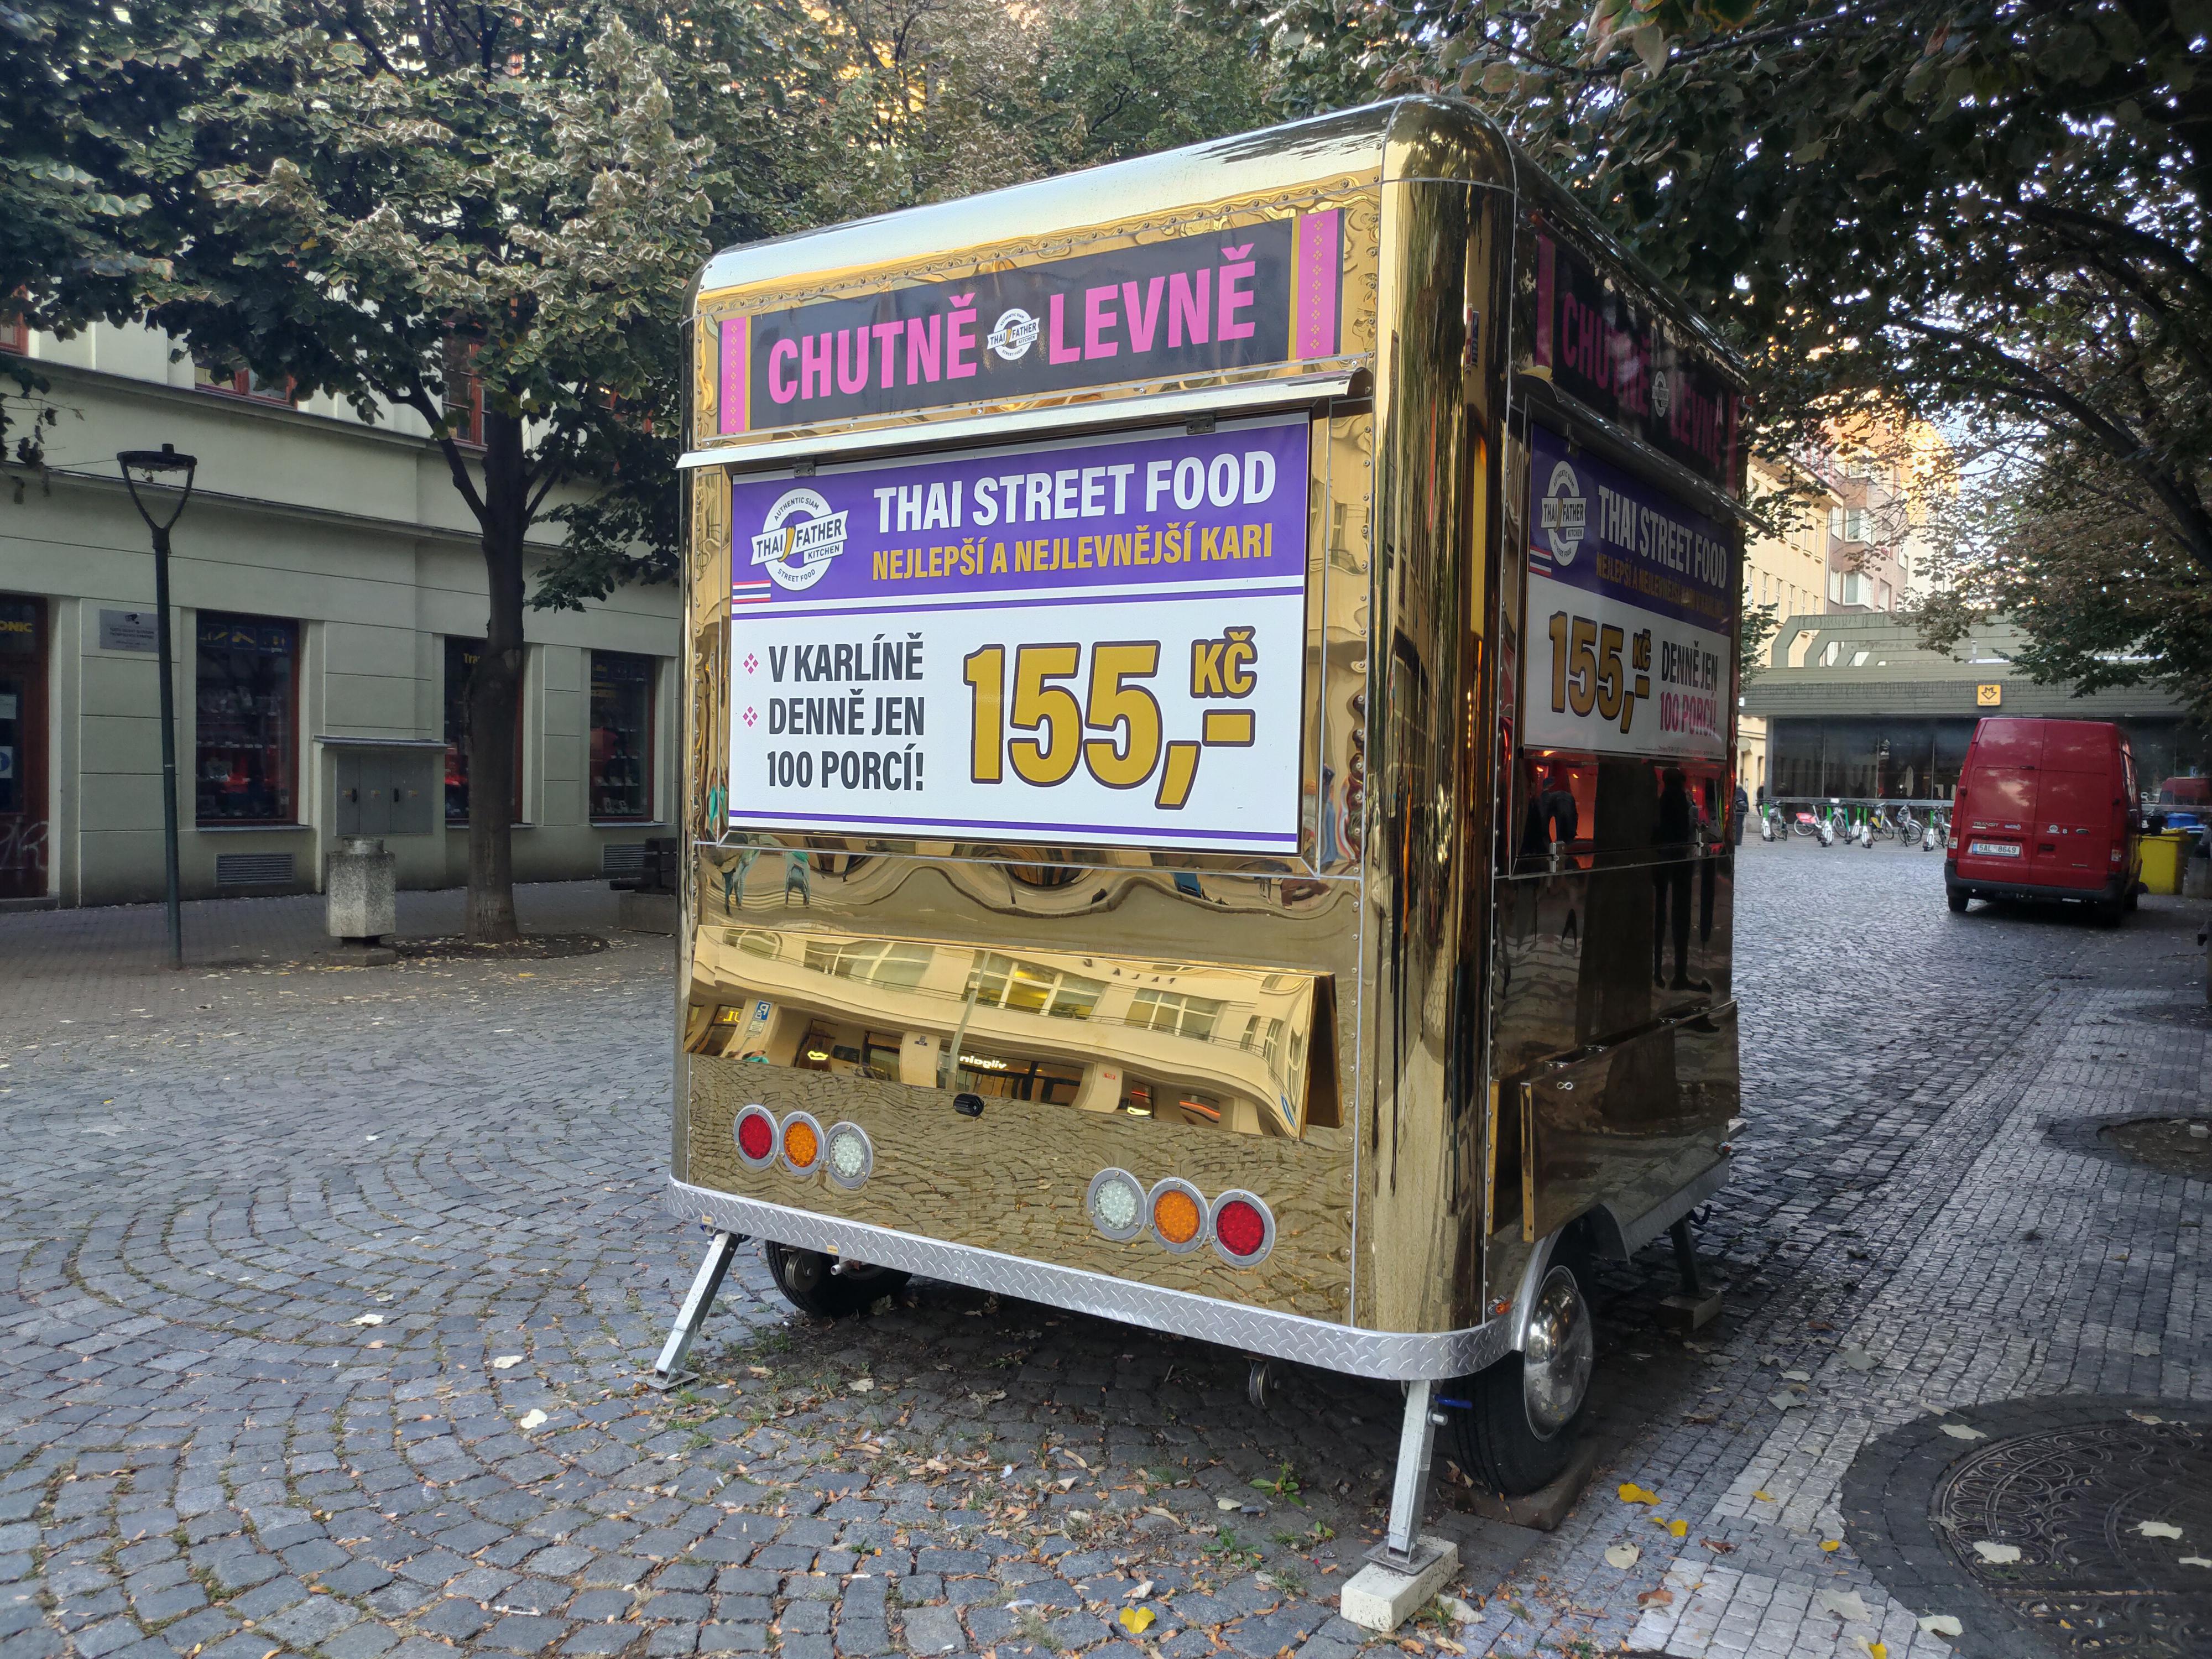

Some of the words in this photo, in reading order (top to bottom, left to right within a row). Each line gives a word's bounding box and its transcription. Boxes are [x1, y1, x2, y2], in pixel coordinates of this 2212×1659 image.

[769, 293, 977, 403] CHUTNĚ
[1050, 243, 1255, 364] LEVNĚ
[990, 332, 1005, 345] THAI
[1012, 322, 1037, 338] FATHER
[774, 497, 804, 521] AUTHENTIC
[805, 498, 819, 510] SIAM
[874, 481, 962, 533] THAI
[972, 464, 1135, 526] STREET
[1146, 451, 1276, 512] FOOD
[1544, 504, 1557, 522] THAI
[1563, 504, 1583, 522] FATHER
[757, 534, 783, 557] THAI
[796, 518, 842, 547] FATHER
[808, 545, 839, 560] KITCHEN
[873, 537, 987, 581] NEJLEPŠÍ
[990, 542, 1008, 574] A
[1015, 521, 1195, 572] NEJLEVNĚJŠÍ
[1201, 523, 1272, 561] KARI
[1599, 484, 1636, 551] THAI
[1640, 507, 1692, 575] STREET
[1694, 534, 1726, 589] FOOD
[778, 568, 799, 582] STREET
[800, 568, 816, 582] FOOD
[769, 646, 788, 682] V
[795, 632, 923, 681] KARLÍNĚ
[1662, 640, 1699, 687] DENNĚ
[1700, 651, 1718, 691] JEN
[769, 688, 864, 734] DENNĚ
[872, 697, 924, 735] JEN
[1660, 691, 1679, 733] 100
[767, 751, 812, 787] 100
[822, 743, 923, 791] PORCÍ!
